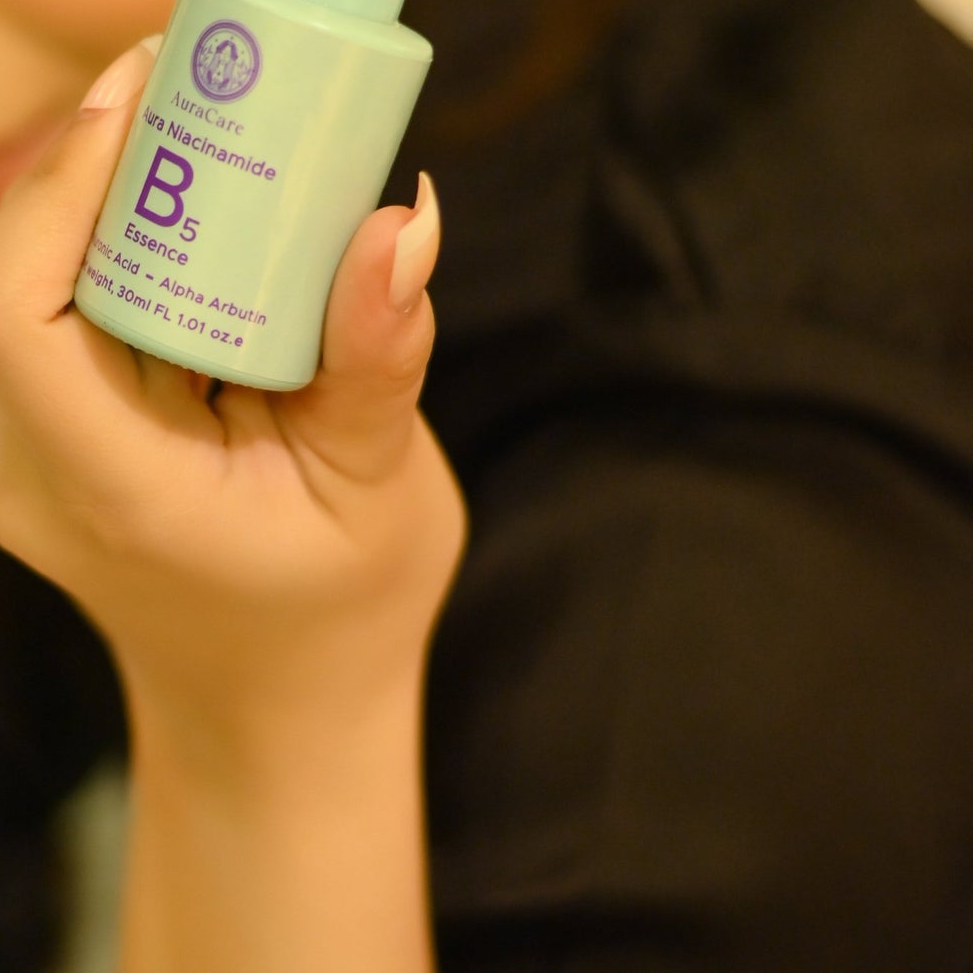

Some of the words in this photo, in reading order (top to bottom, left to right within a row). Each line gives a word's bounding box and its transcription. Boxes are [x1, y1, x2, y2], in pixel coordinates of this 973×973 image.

[171, 91, 244, 135] AuraCare
[142, 105, 165, 132] Aura
[167, 121, 276, 180] Niacinamide
[124, 222, 188, 265] Essence
[113, 252, 140, 275] Acid
[159, 277, 204, 304] Alpha
[208, 297, 267, 326] Arbutin
[117, 285, 152, 311] 30ml
[153, 303, 171, 322] FL
[177, 313, 206, 334] 1.01
